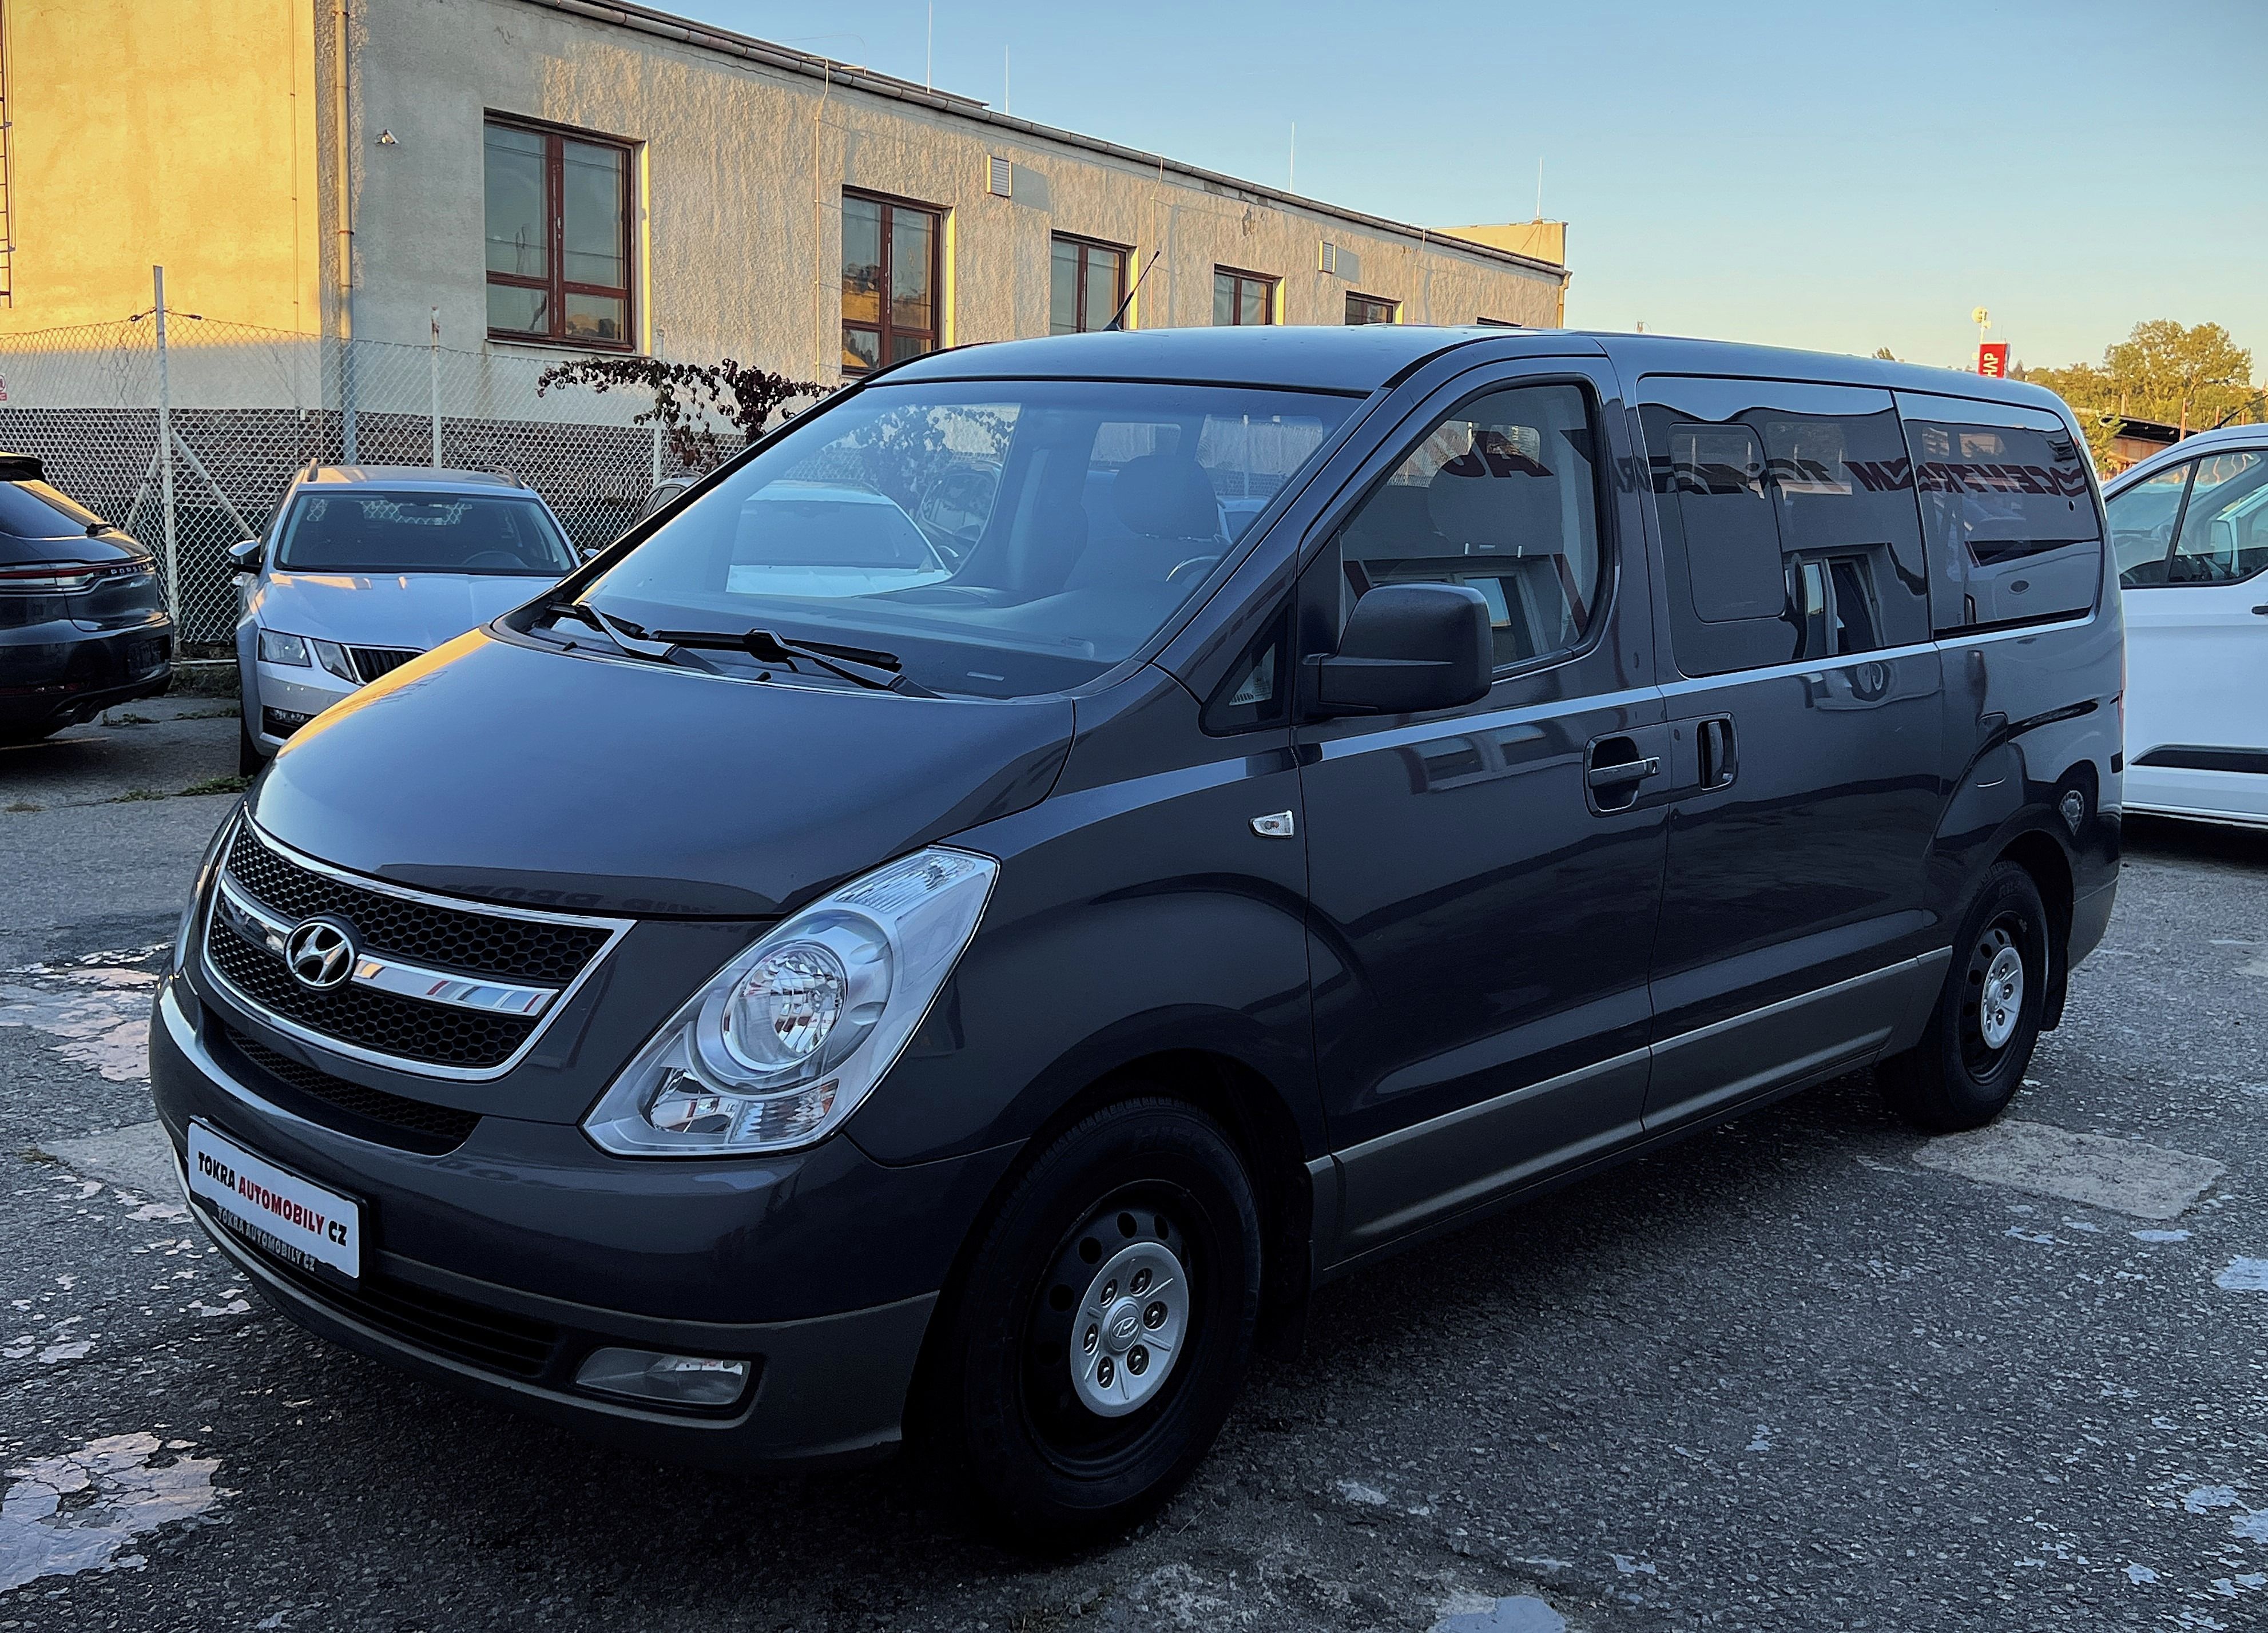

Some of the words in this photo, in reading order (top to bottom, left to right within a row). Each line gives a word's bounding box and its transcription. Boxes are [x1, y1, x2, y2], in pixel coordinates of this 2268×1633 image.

[198, 1150, 236, 1191] TOKRA
[238, 1175, 325, 1235] AUTOMOBILY
[328, 1220, 347, 1247] CZ
